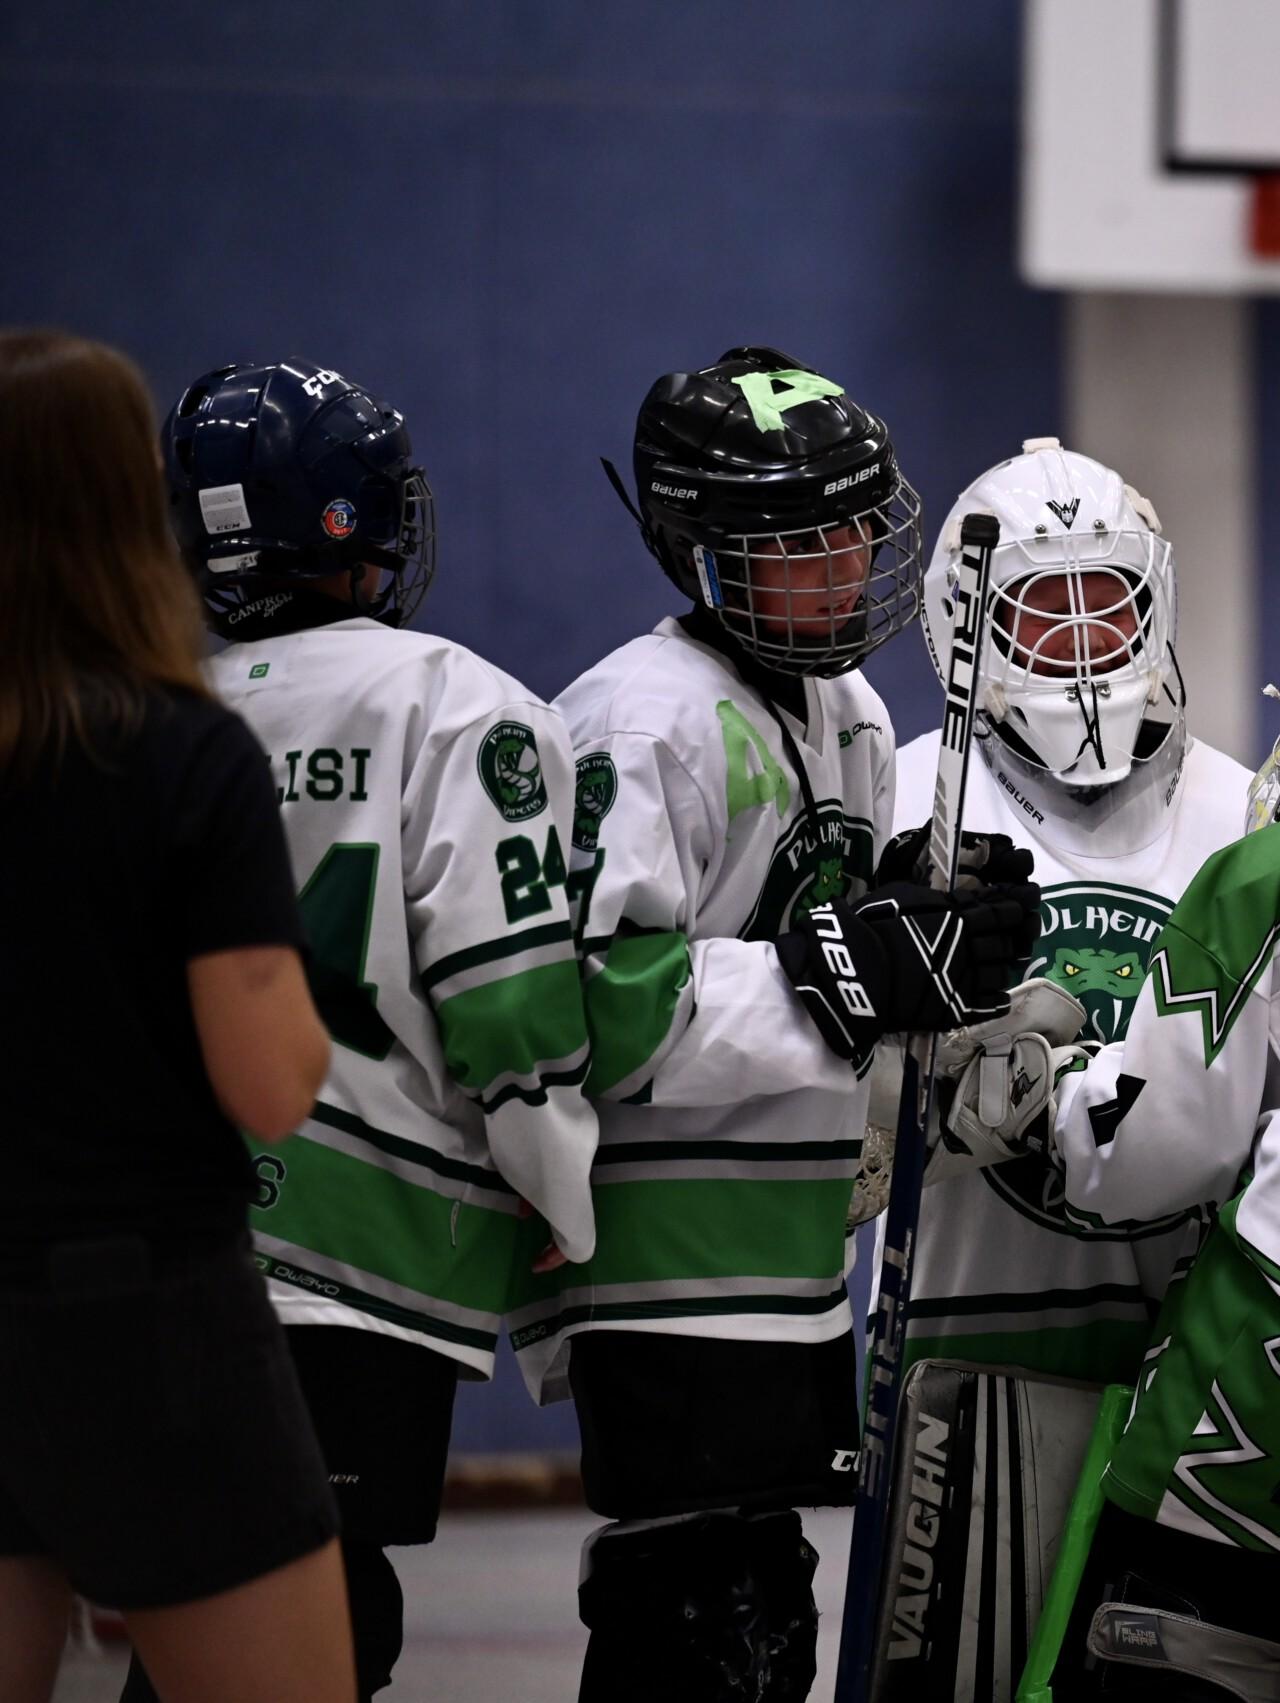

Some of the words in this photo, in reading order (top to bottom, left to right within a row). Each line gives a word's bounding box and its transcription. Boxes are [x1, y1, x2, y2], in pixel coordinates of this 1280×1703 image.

[650, 481, 698, 500] BAUER
[824, 463, 880, 496] BAUER
[941, 552, 985, 754] TRUE
[277, 749, 370, 801] ISI
[998, 772, 1045, 825] BAUER
[496, 824, 568, 925] 24
[808, 902, 878, 1018] BAU
[859, 1244, 904, 1500] TRUE
[887, 1412, 950, 1661] VAUGHN
